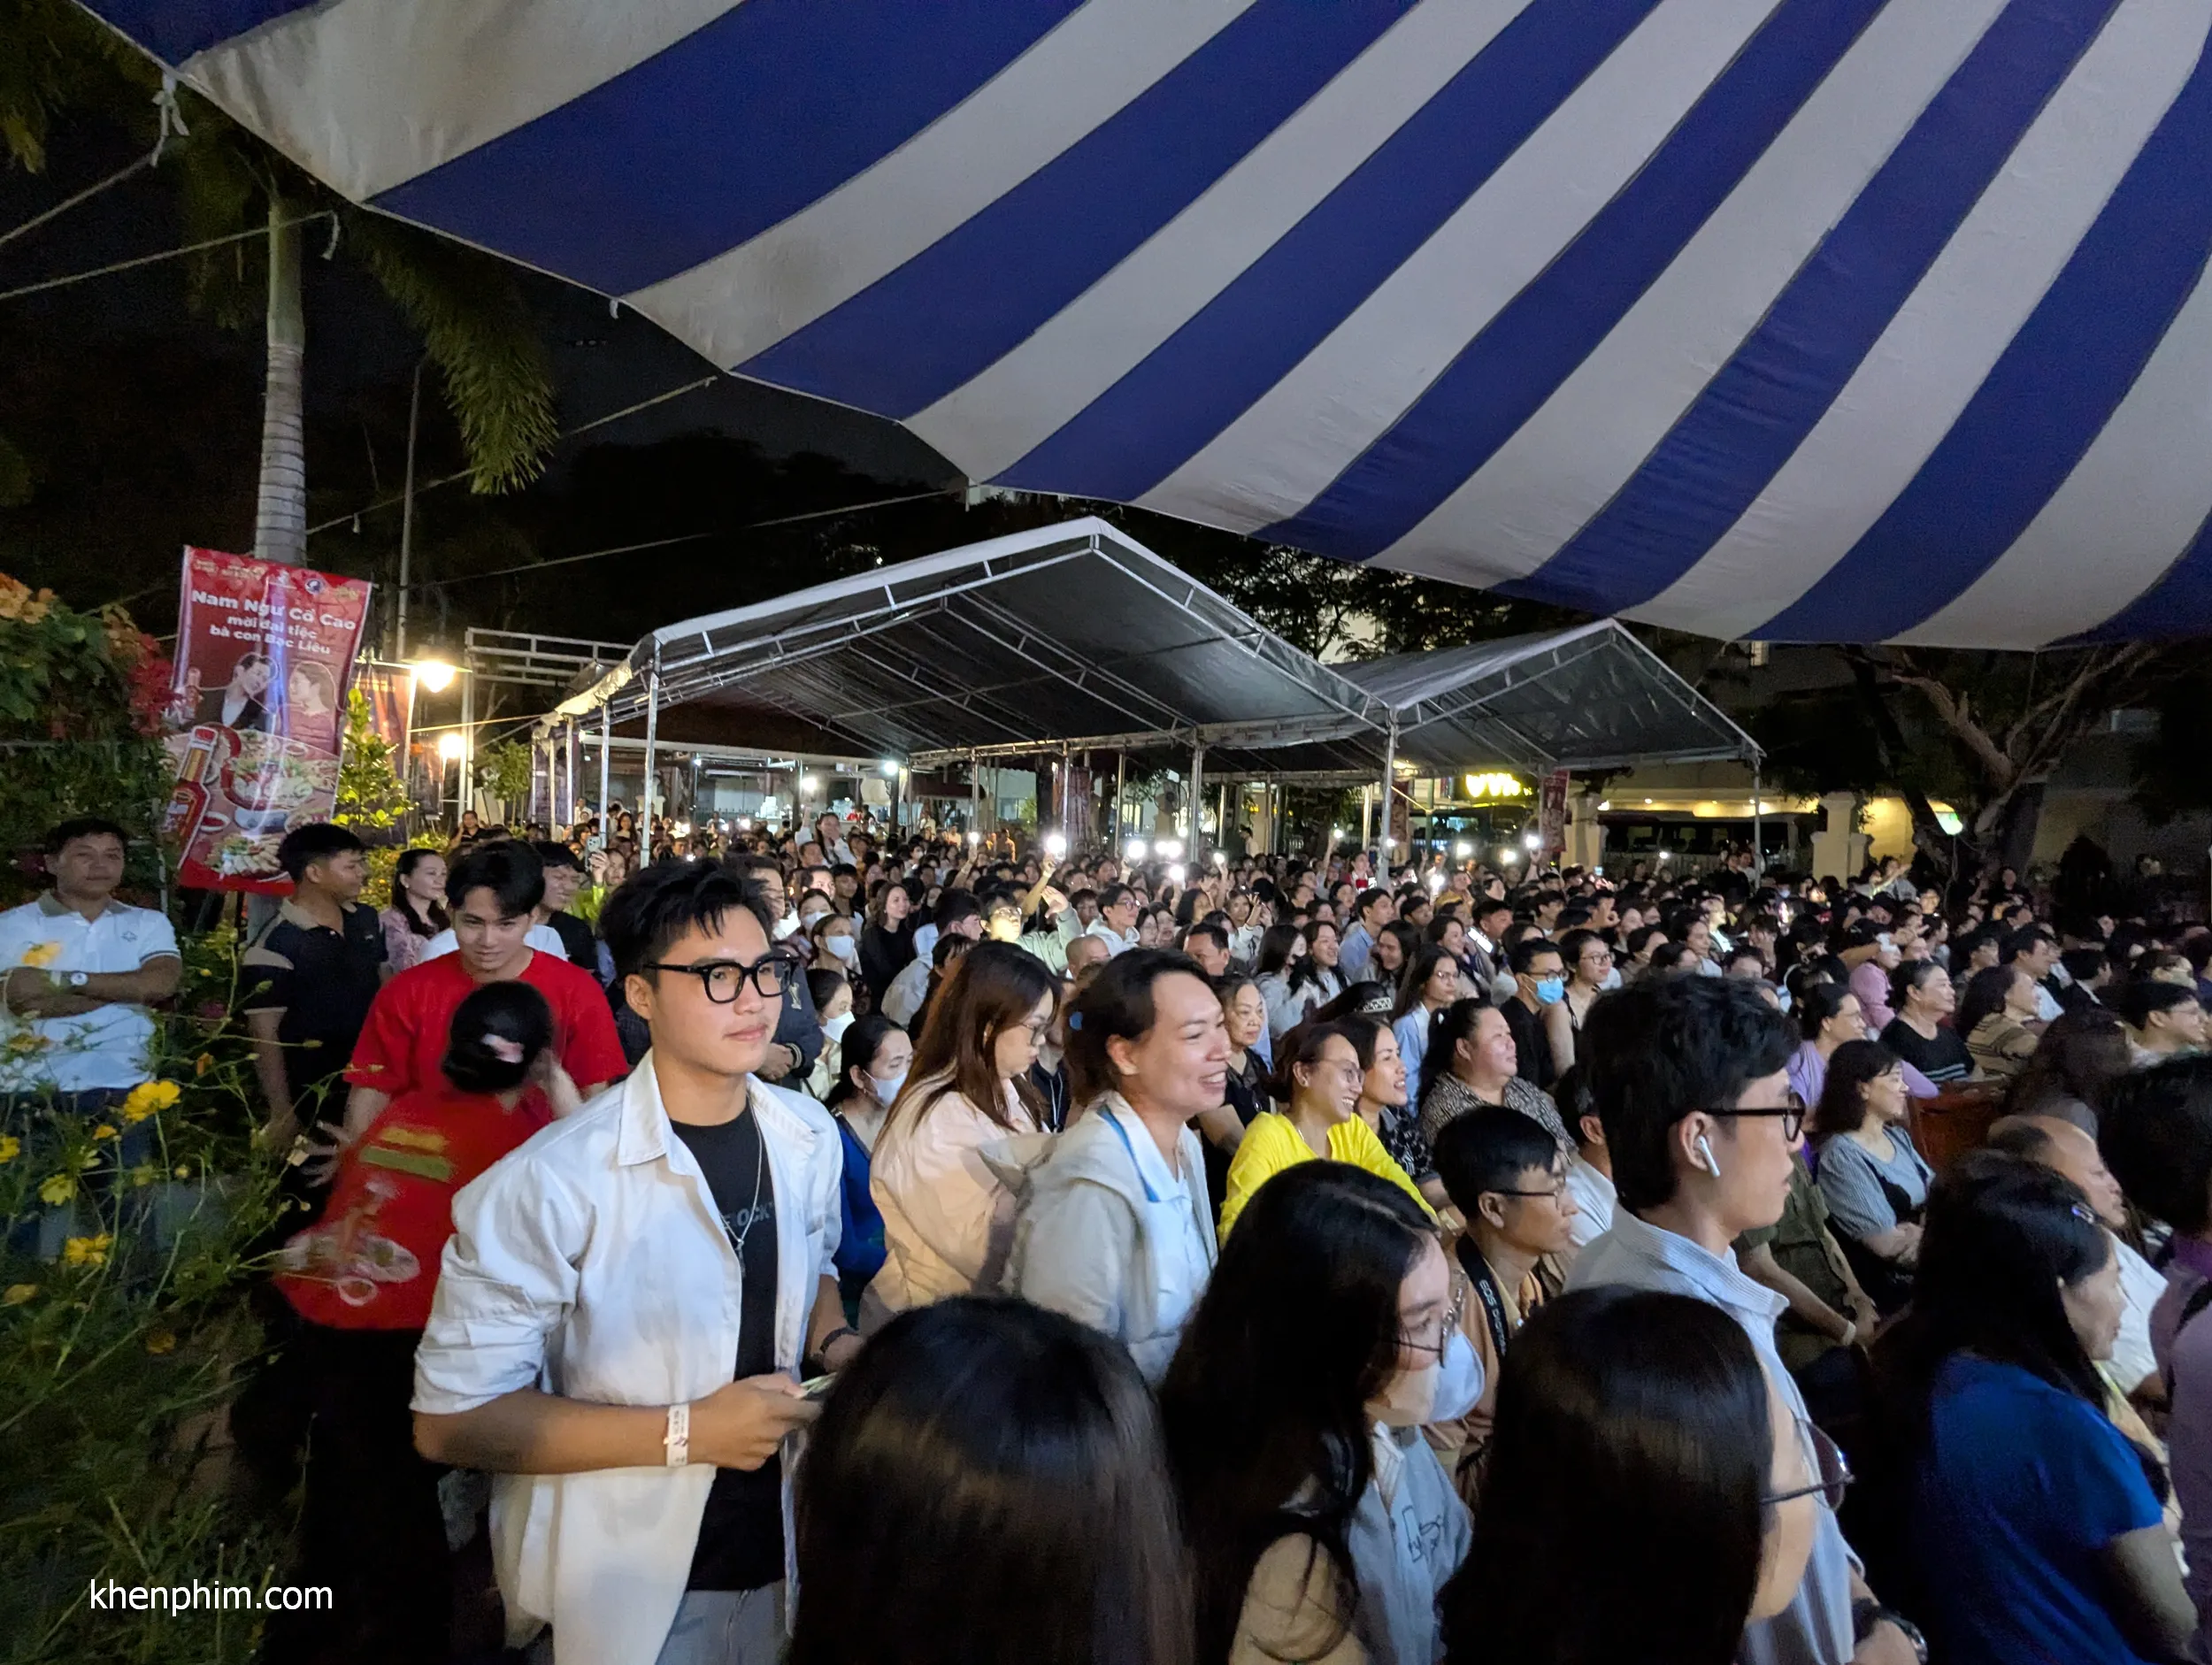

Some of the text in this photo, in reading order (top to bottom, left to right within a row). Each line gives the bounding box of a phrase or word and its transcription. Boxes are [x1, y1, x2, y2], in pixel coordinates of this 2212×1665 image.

[192, 589, 239, 610] Nam
[243, 598, 286, 618] Ngư
[319, 613, 357, 631] Cao
[233, 629, 262, 642] con
[1479, 1279, 1497, 1307] EOS
